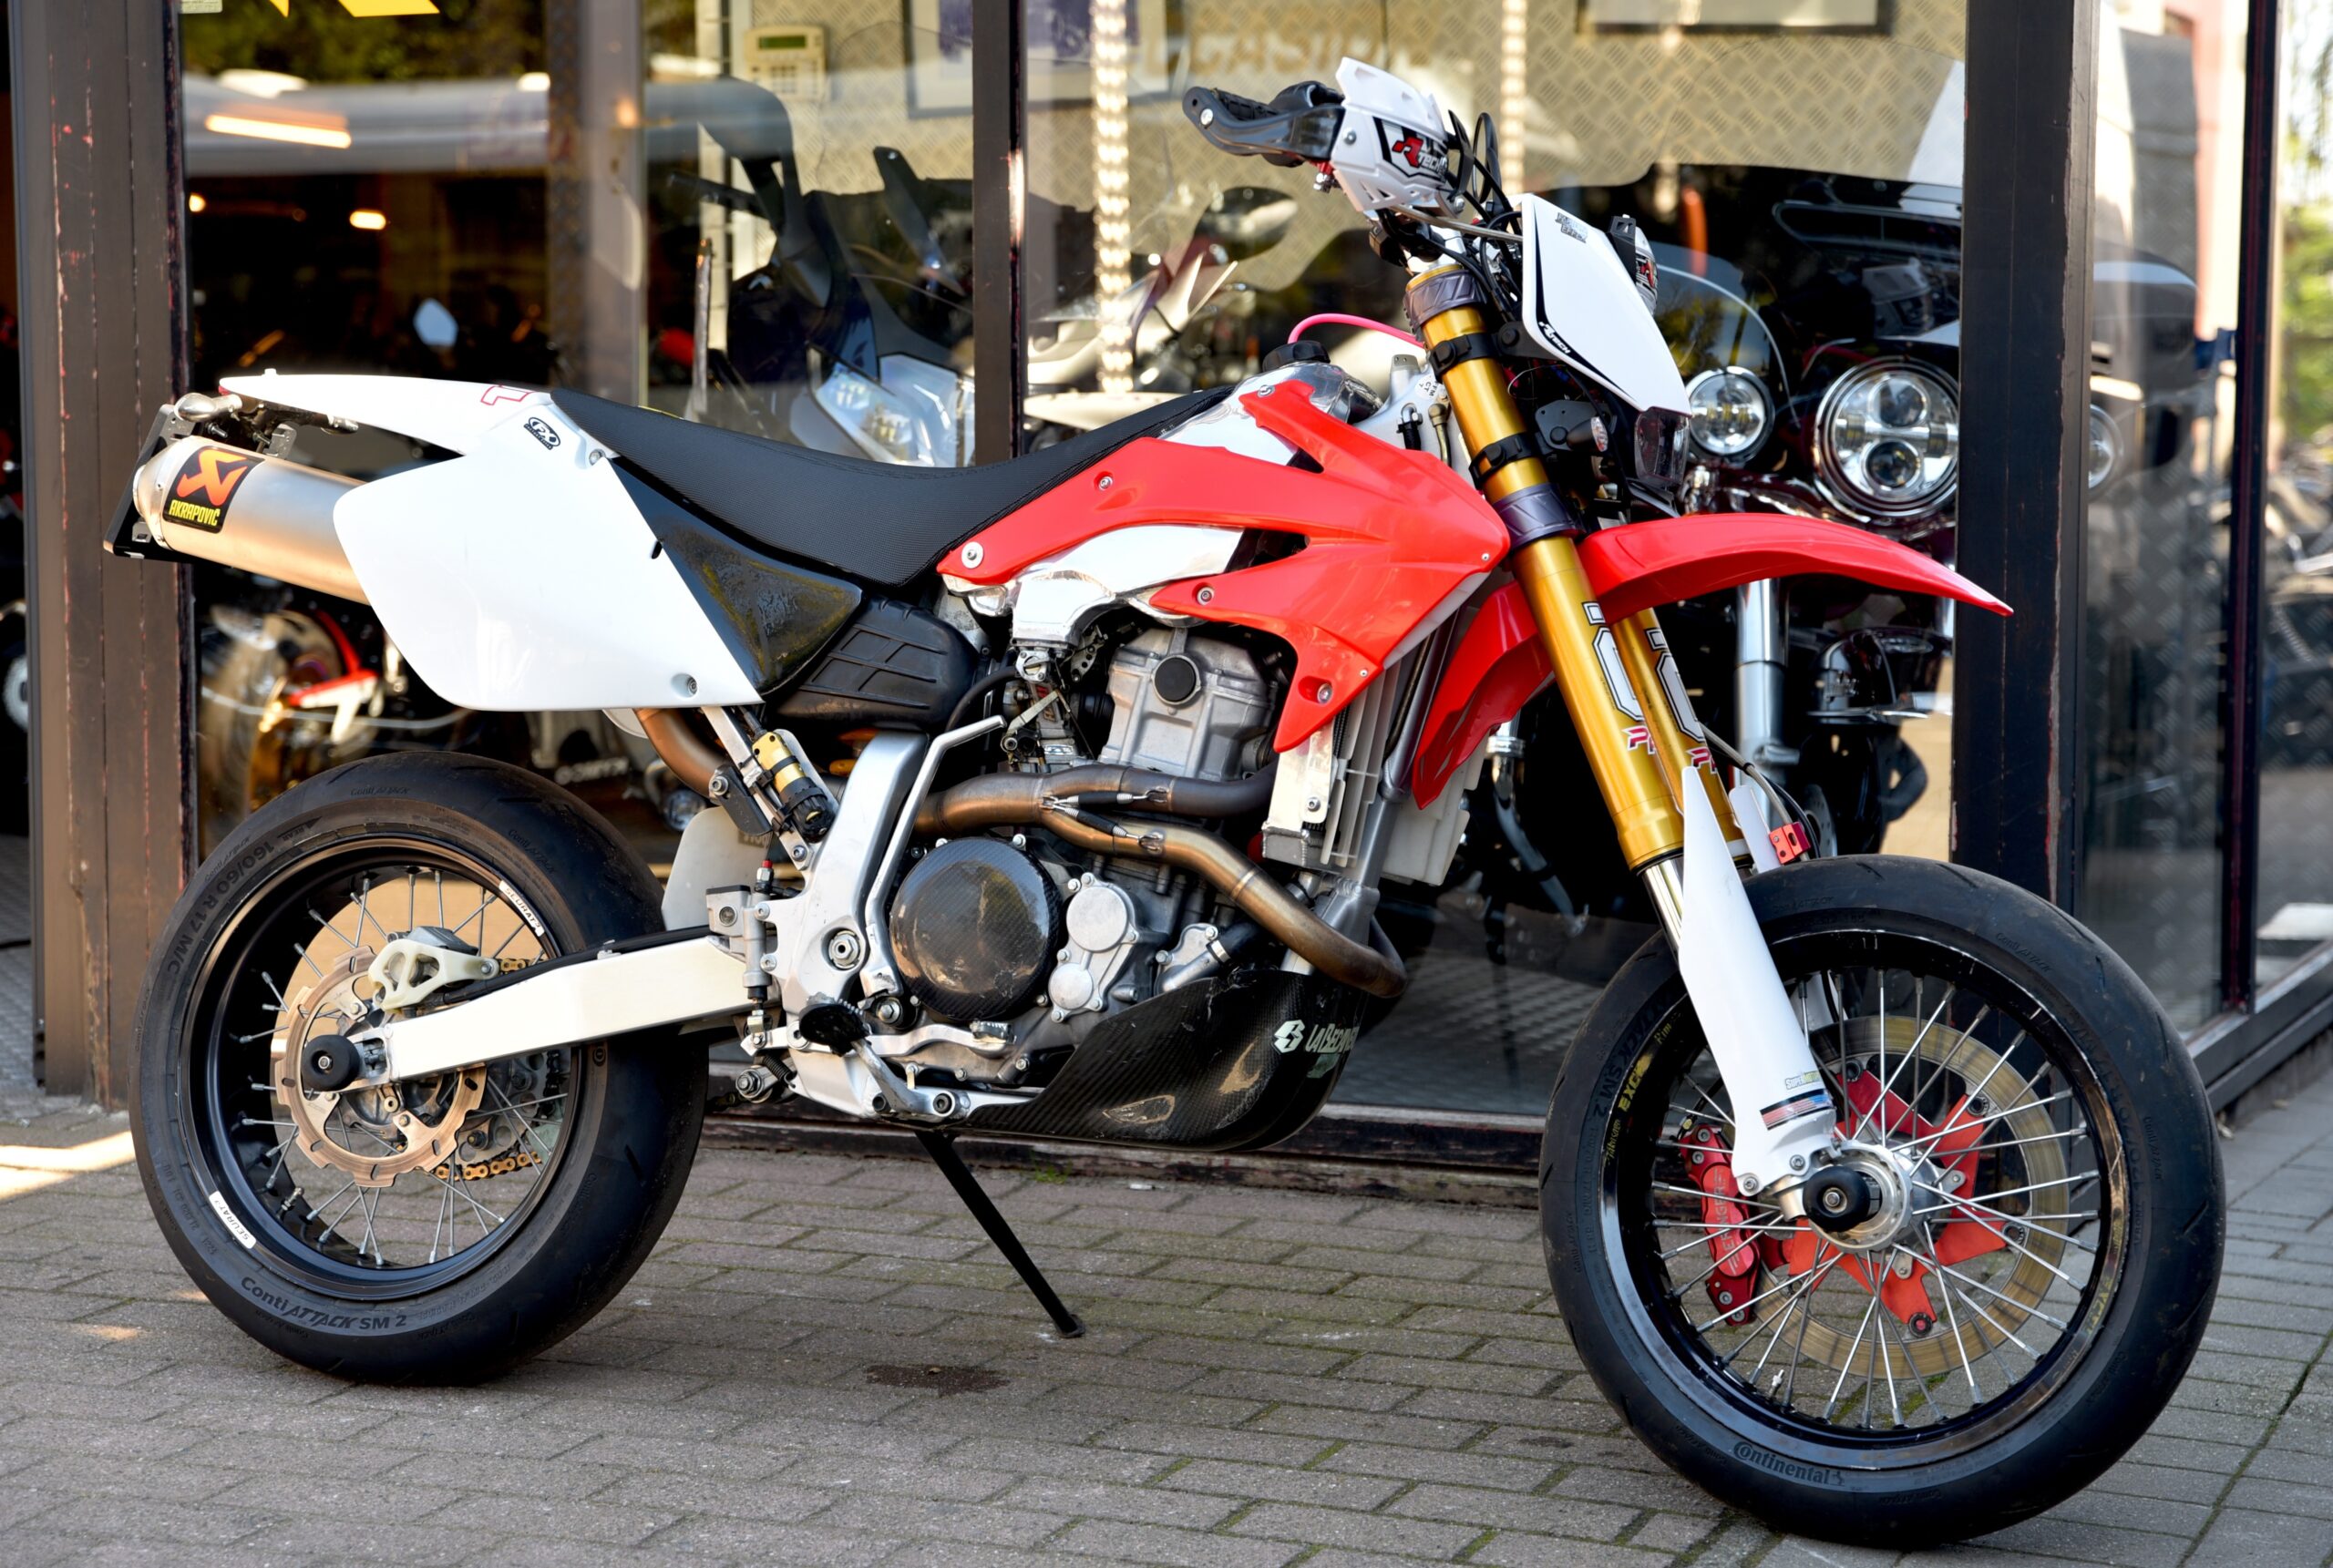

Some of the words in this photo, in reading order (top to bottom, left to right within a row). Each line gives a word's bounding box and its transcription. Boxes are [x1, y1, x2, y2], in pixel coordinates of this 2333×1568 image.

[216, 841, 275, 895] 160/60
[201, 894, 219, 908] R
[189, 909, 207, 931] 17
[167, 934, 193, 975] M/C
[359, 1317, 393, 1331] SM
[396, 1312, 408, 1327] 2
[1732, 1440, 1832, 1485] Continental
